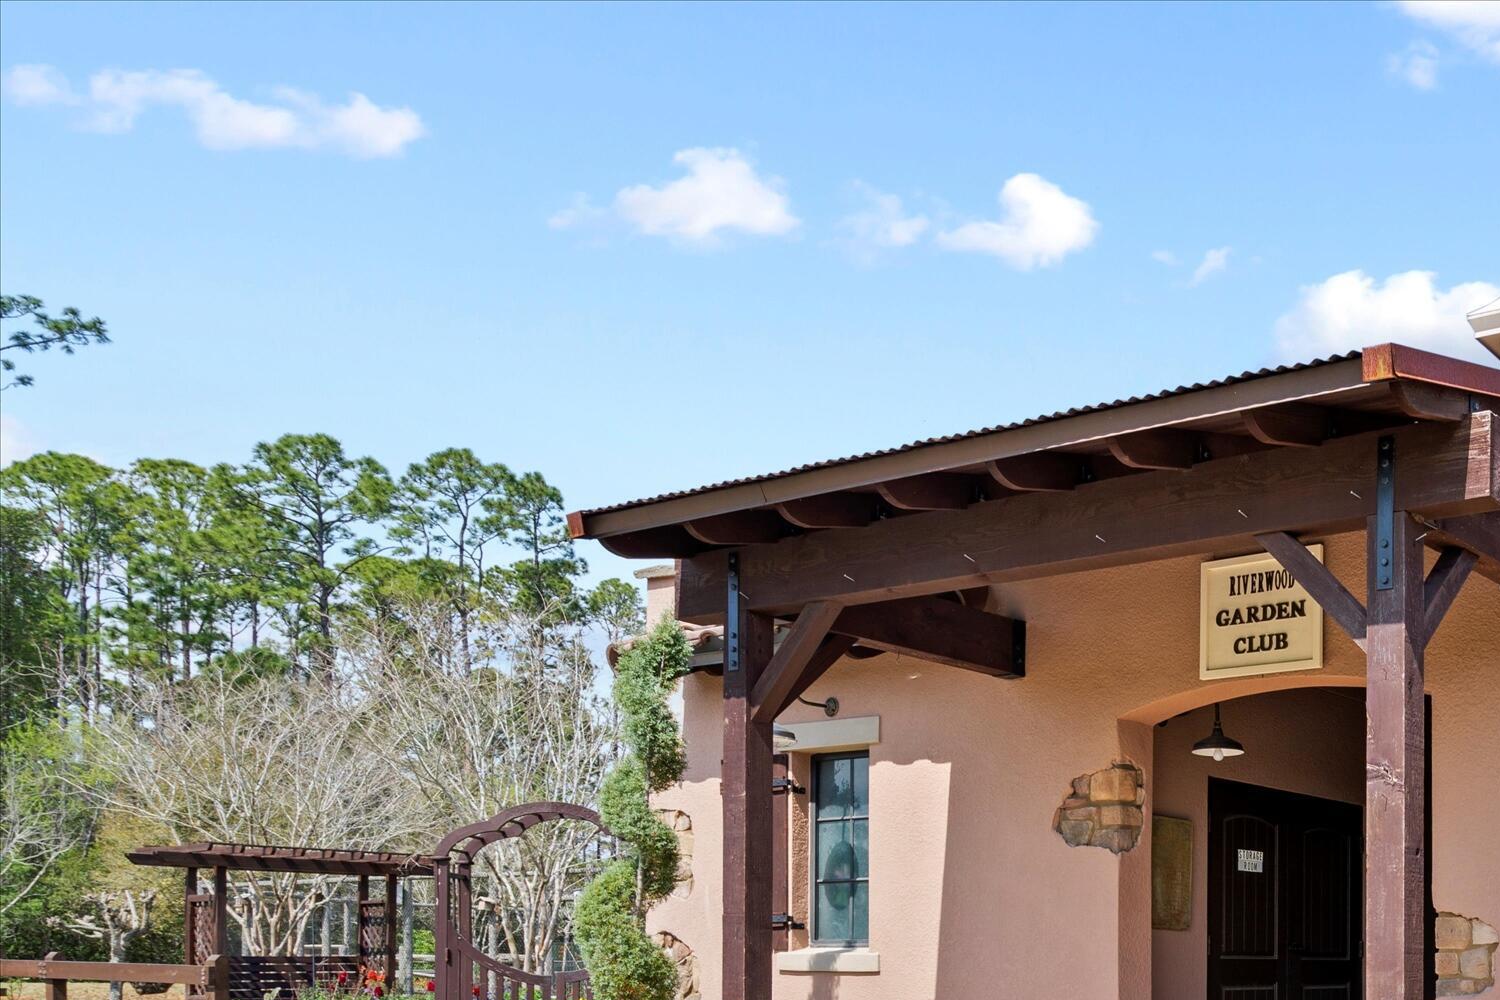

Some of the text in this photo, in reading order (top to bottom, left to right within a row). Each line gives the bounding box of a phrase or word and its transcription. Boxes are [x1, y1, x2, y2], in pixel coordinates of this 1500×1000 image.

[1229, 569, 1295, 596] RIVERWOOD
[1215, 599, 1306, 627] GARDEN
[1233, 632, 1289, 654] CLUB
[1238, 850, 1263, 860] STORAGE
[1243, 861, 1258, 871] ROOM
